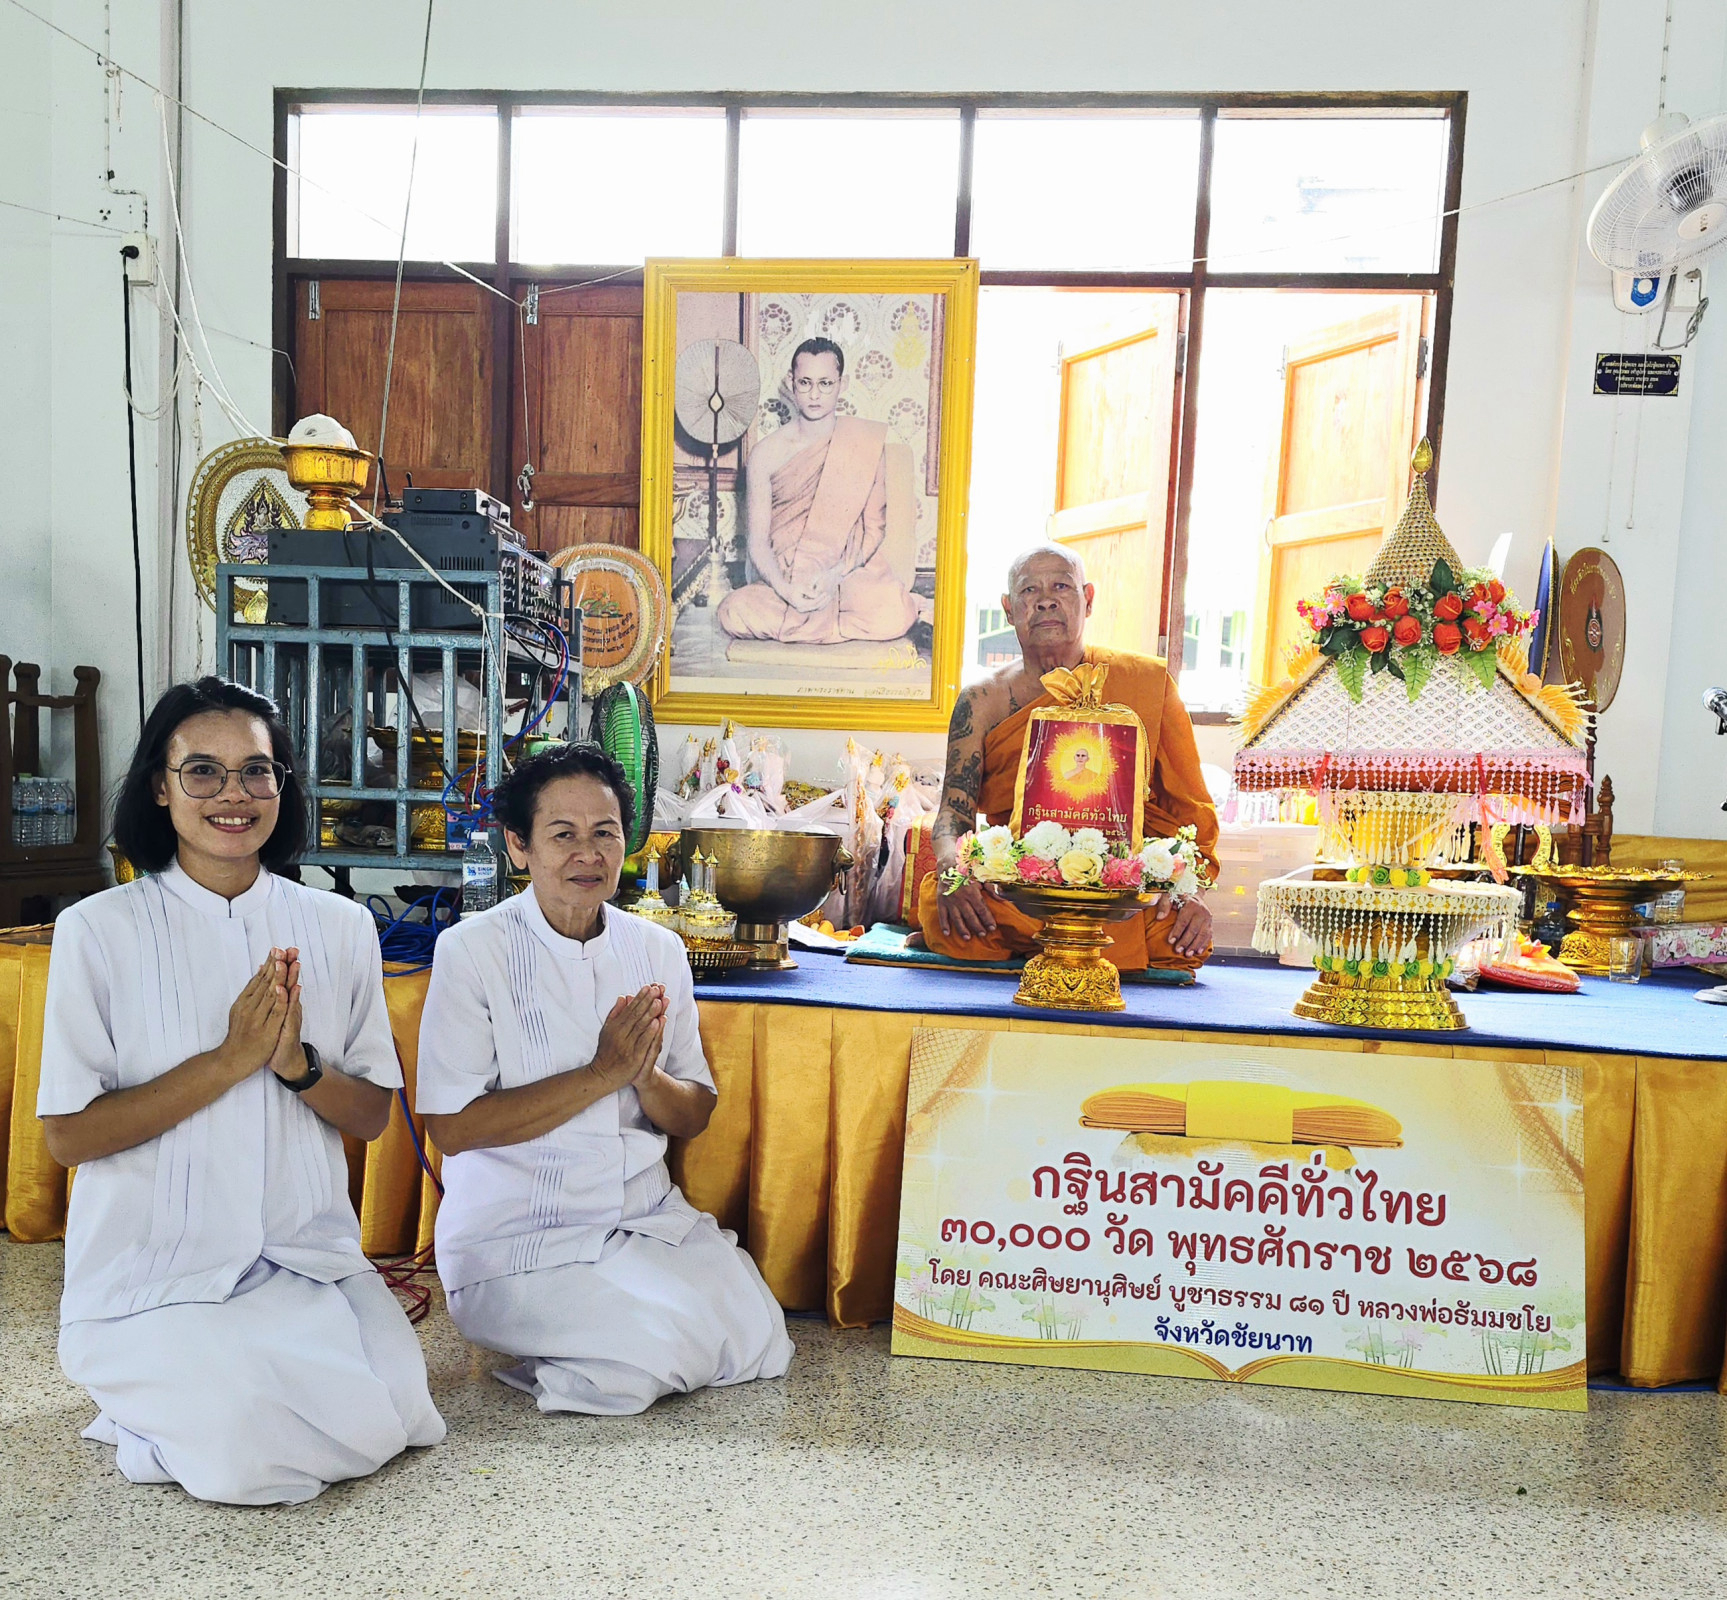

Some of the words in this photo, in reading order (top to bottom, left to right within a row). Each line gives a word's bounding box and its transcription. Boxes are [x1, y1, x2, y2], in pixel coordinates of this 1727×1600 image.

[1028, 804, 1127, 823] กฐินสามัคคีทั่วไทย
[1032, 1151, 1446, 1227] กฐินสามัคคีทั่วไทย
[941, 1218, 1091, 1252] ๓๐,๐๐๐
[1104, 1212, 1154, 1257] วัด
[1167, 1224, 1392, 1276] พุทธศักราช
[1406, 1248, 1538, 1288] ๒๕๖๘
[928, 1258, 971, 1286] โดย
[978, 1267, 1162, 1307] คณะศิษยานุศิษย์
[1168, 1284, 1282, 1312] บูชาธรรม
[1289, 1294, 1325, 1316] ๘๑
[1332, 1288, 1351, 1316] ปี
[1358, 1298, 1551, 1333] หลวงพ่อธัมมชโย
[1154, 1315, 1313, 1354] จังหวัดชัยนาท
